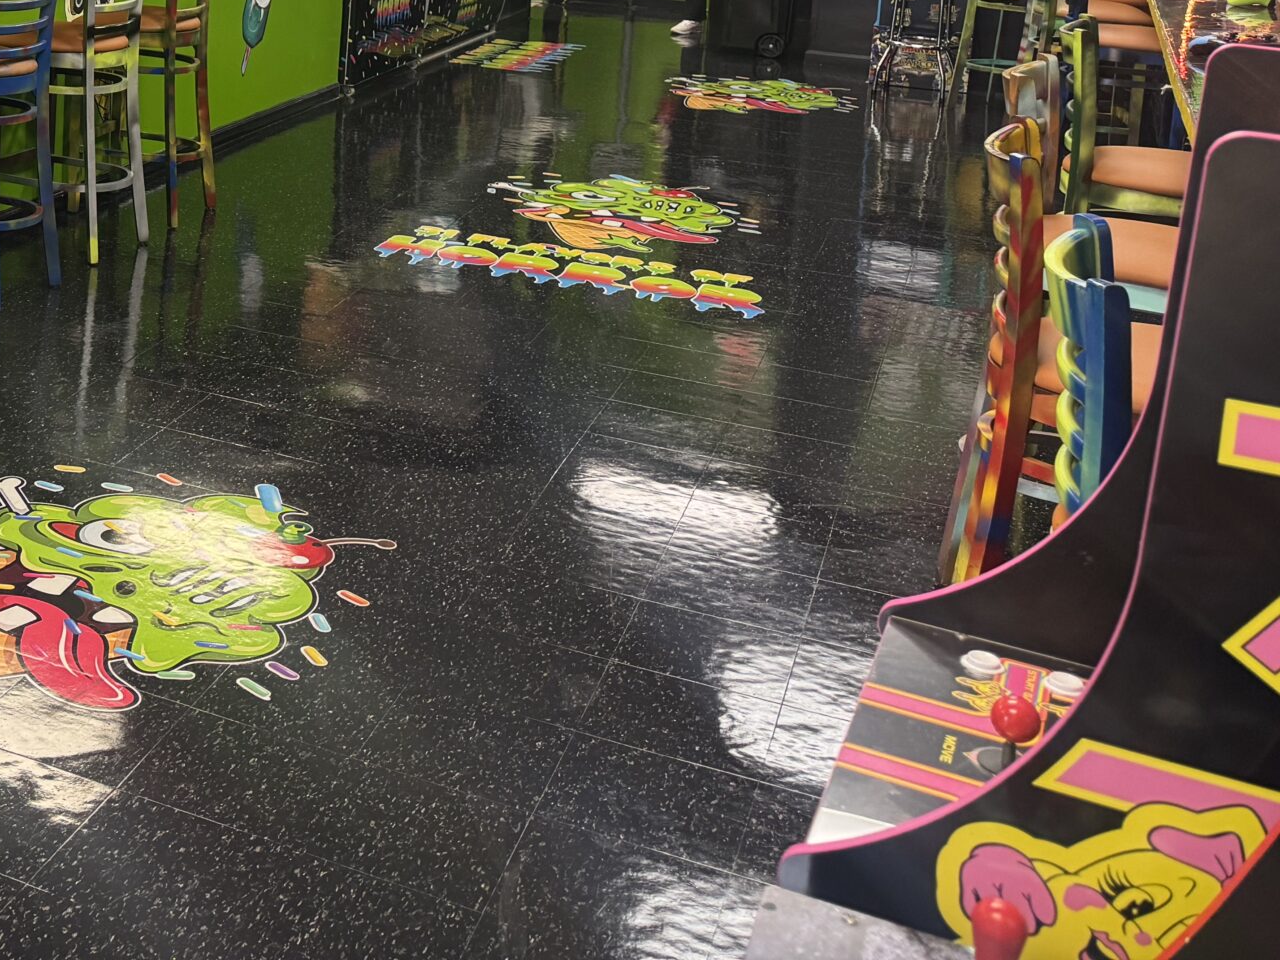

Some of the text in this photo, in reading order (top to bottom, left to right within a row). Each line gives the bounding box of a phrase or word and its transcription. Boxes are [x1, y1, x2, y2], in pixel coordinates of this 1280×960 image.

[373, 234, 766, 320] HORROR
[414, 225, 754, 289] 31 FLAVORS OF
[938, 734, 958, 765] MOVE
